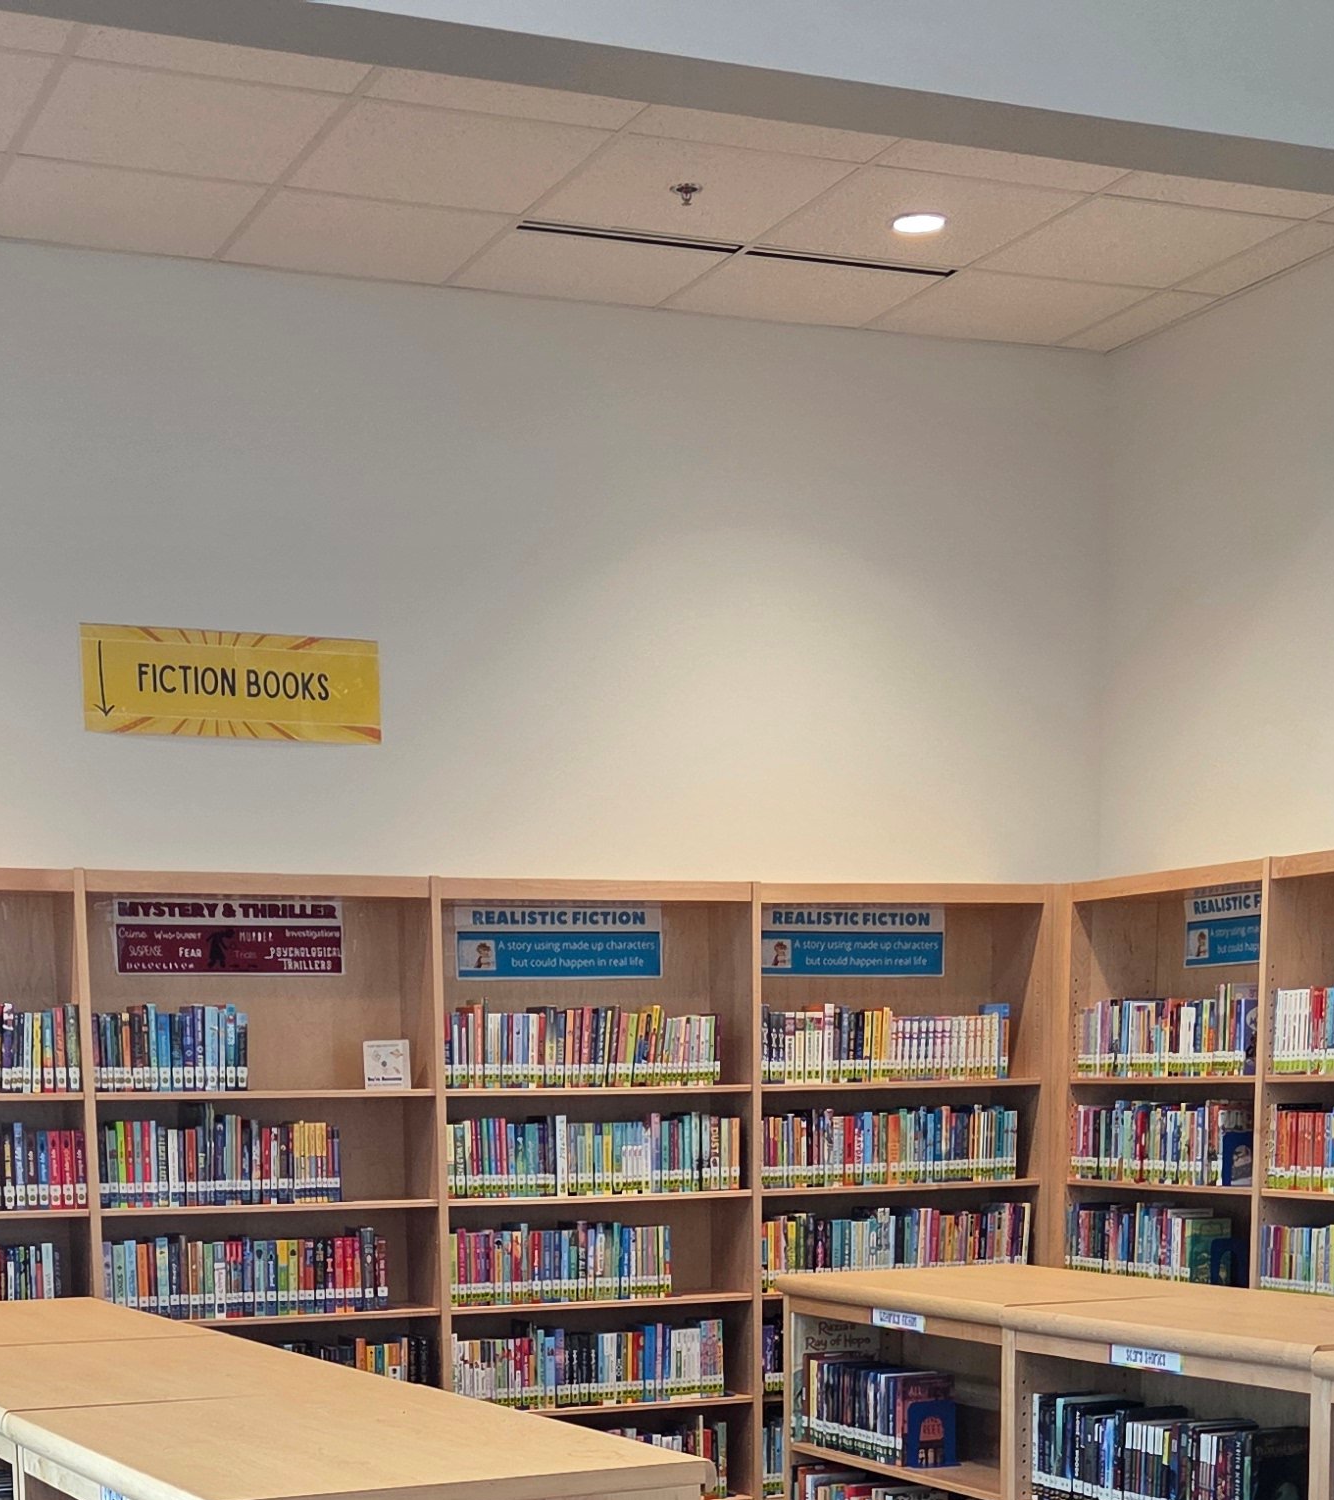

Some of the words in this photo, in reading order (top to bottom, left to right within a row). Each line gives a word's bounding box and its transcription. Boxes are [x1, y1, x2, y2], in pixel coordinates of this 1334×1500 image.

[137, 663, 236, 697] FICTION
[247, 669, 329, 701] BOOKS
[117, 901, 219, 918] MYSTERY
[221, 902, 237, 918] &
[239, 903, 338, 919] THRILLER
[1194, 895, 1251, 915] REALISTIC
[472, 911, 567, 925] REALISTIC
[572, 911, 646, 925] FICTION
[772, 911, 859, 925] REALISTIC
[862, 912, 930, 926] FICTION
[239, 931, 274, 942] MURDER
[285, 929, 340, 940] Investigations
[498, 941, 505, 949] A
[507, 941, 532, 952] story
[534, 941, 560, 952] using
[562, 940, 589, 950] made
[591, 942, 604, 952] up
[605, 940, 655, 950] characters
[794, 940, 800, 948] A
[802, 940, 825, 951] story
[827, 941, 852, 951] using
[854, 939, 878, 949] made
[880, 941, 892, 951] up
[893, 939, 938, 949] characters
[178, 946, 202, 958] FEAR
[264, 947, 342, 959] PSYCHOLOGICAL
[278, 957, 332, 970] THRILLERS
[511, 957, 528, 967] but
[530, 957, 557, 967] could
[559, 957, 595, 969] happen
[597, 957, 606, 966] in
[609, 956, 627, 966] real
[629, 956, 644, 967] life
[805, 956, 820, 966] but
[822, 956, 847, 966] could
[849, 956, 882, 967] happen
[884, 956, 893, 966] in
[894, 956, 912, 966] real
[913, 956, 927, 966] life
[711, 1126, 719, 1153] DUST
[805, 1336, 828, 1351] Ray
[830, 1334, 842, 1346] of
[843, 1333, 871, 1348] Hope
